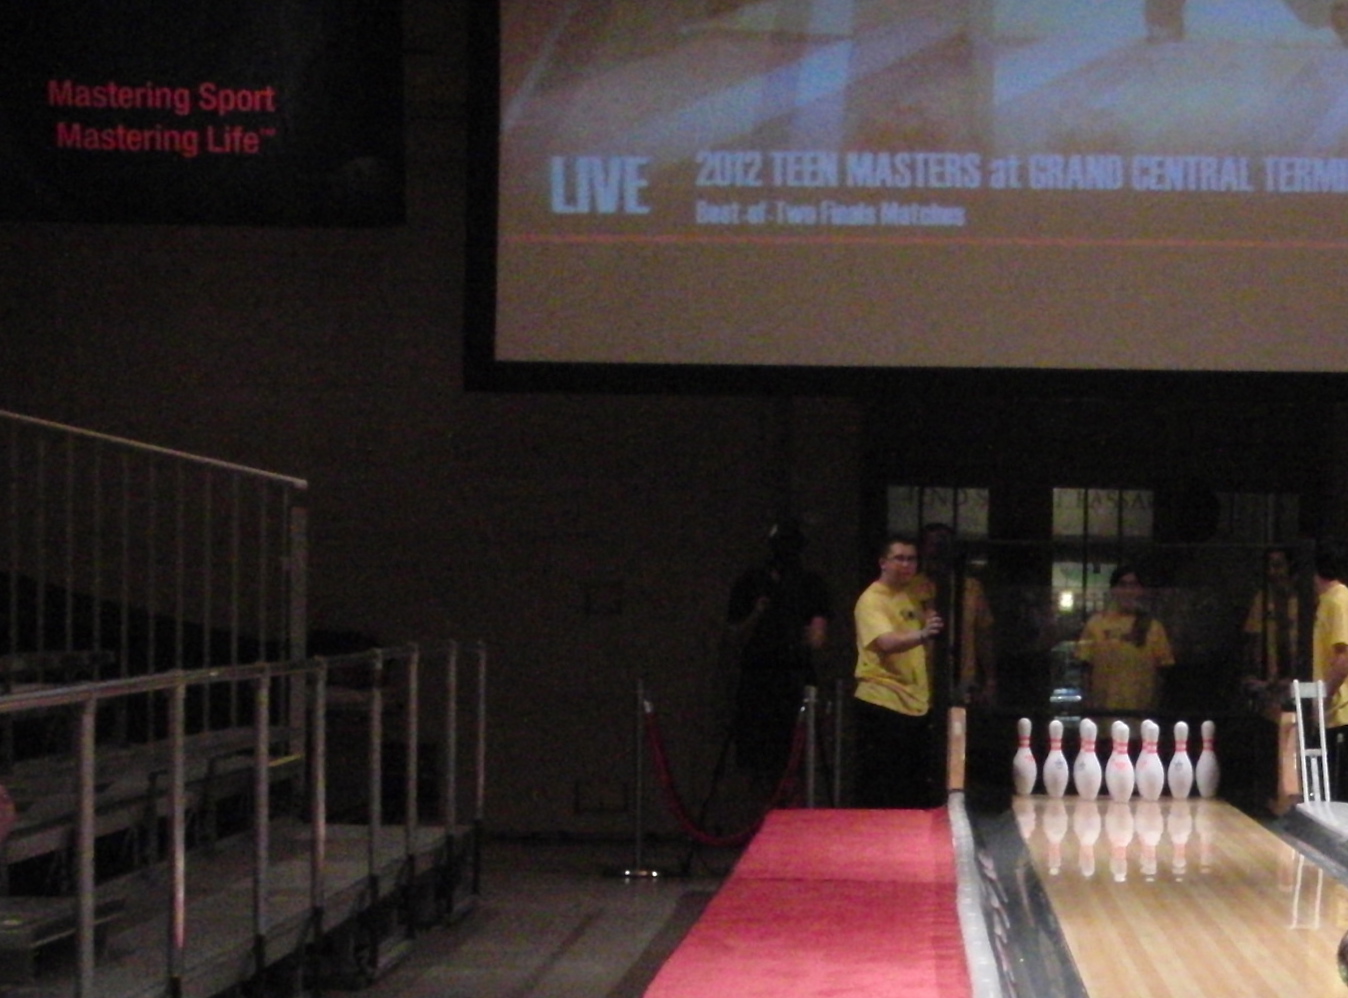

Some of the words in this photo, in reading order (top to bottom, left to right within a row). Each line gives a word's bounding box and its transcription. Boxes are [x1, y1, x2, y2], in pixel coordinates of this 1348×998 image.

[47, 79, 191, 115] Mastering
[199, 82, 275, 114] Sport
[56, 122, 198, 157] Mastering
[550, 155, 651, 214] LIVE
[695, 151, 763, 188] 2012
[771, 151, 839, 188] TEEN
[846, 152, 981, 189] MASTERS
[989, 155, 1022, 190] at
[1029, 154, 1123, 191] GRAND
[1132, 155, 1254, 193] CENTRAL
